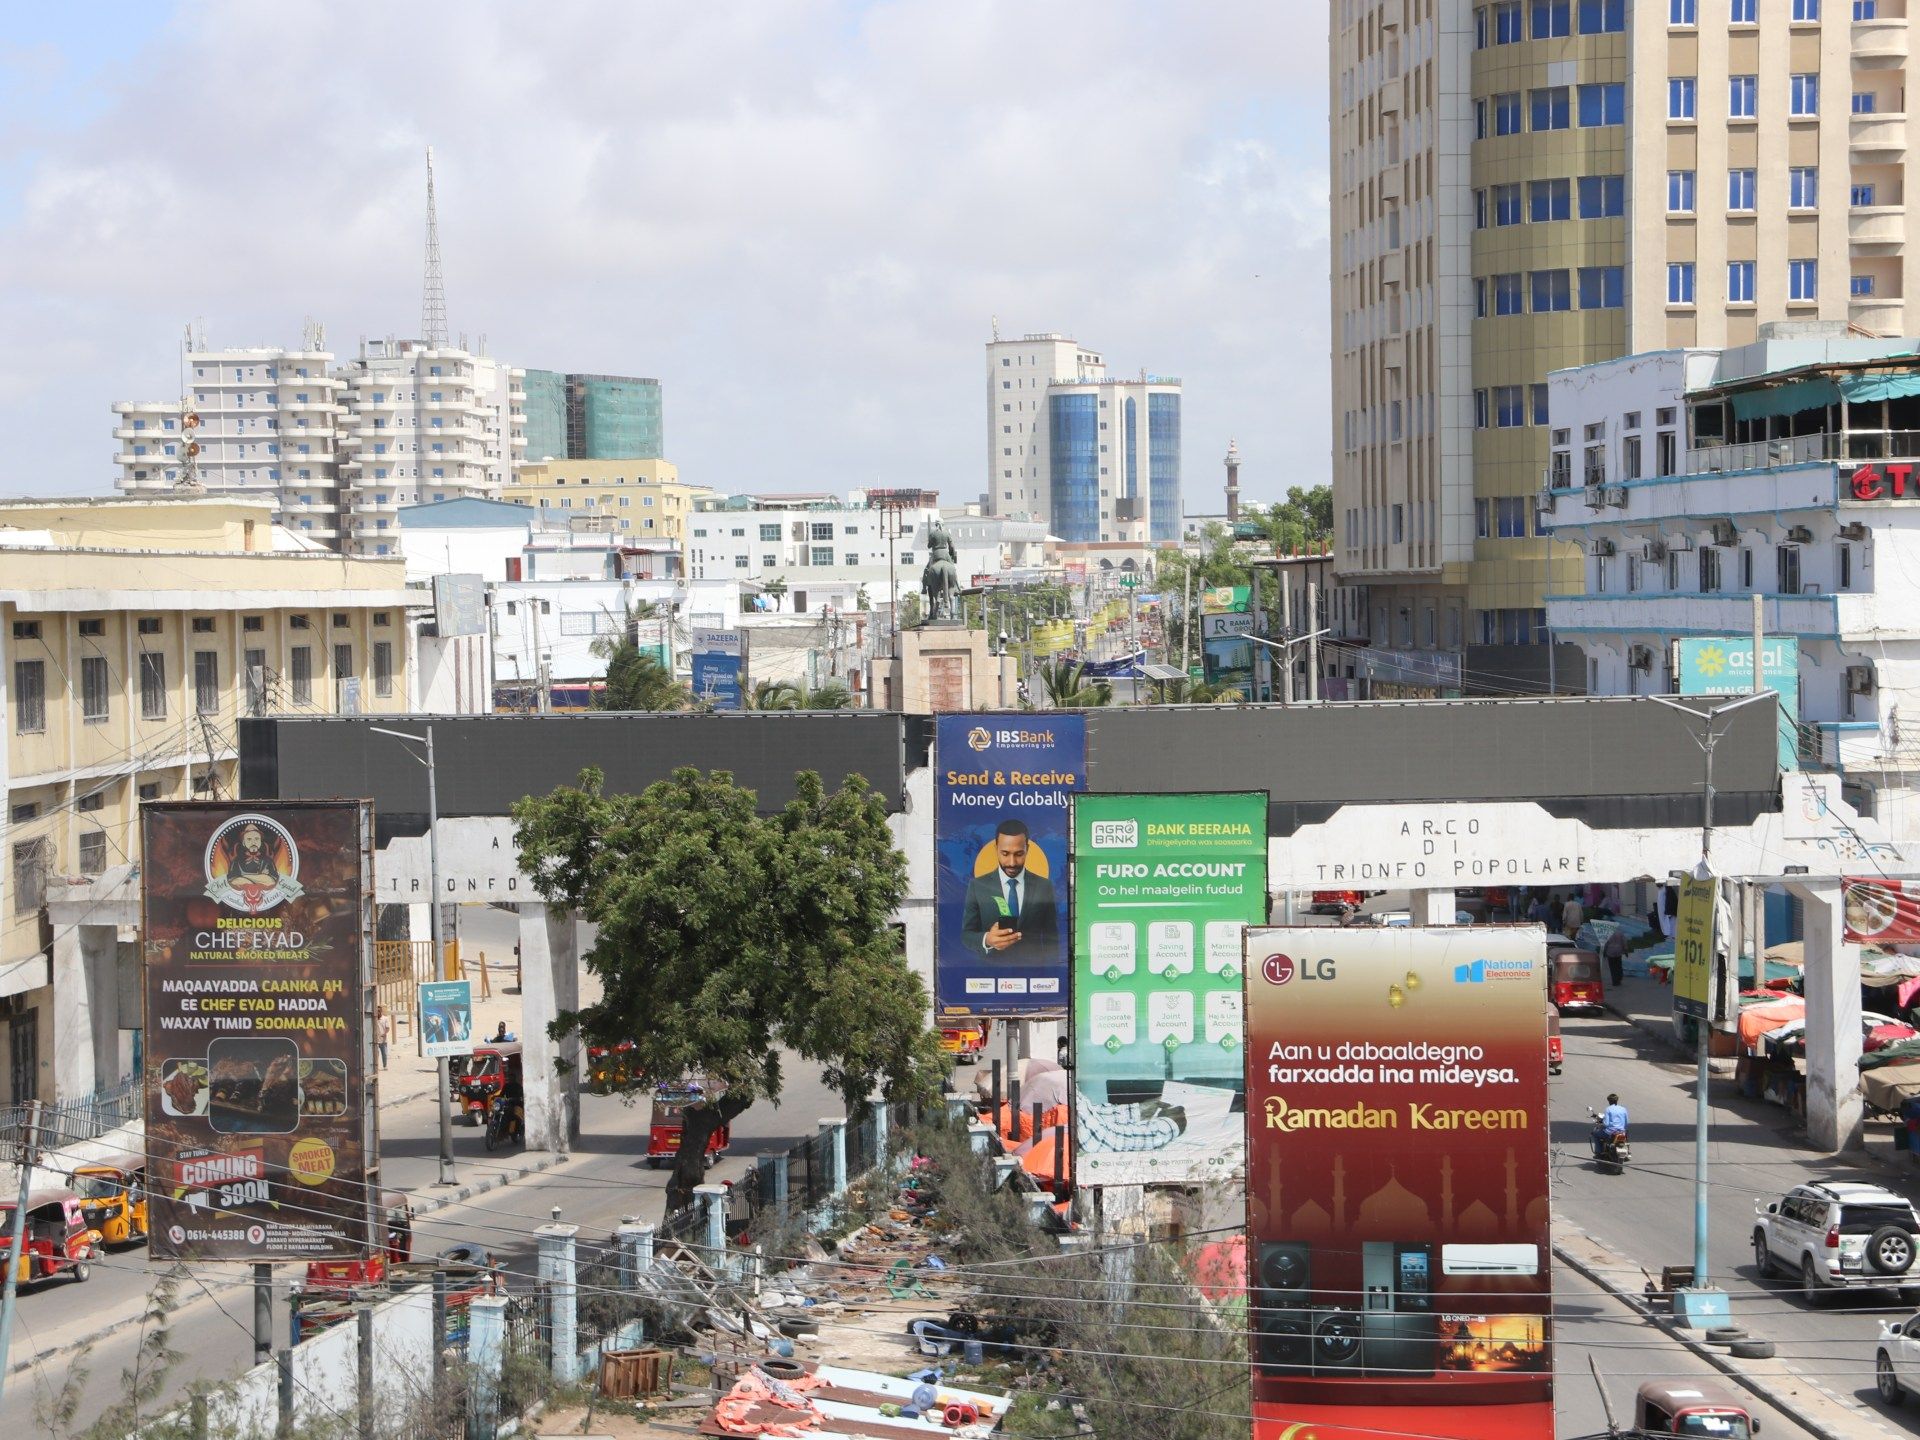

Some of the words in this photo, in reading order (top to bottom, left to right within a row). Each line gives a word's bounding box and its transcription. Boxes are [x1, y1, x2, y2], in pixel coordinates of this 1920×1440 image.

[706, 634, 738, 642] JAZEERA
[996, 730, 1054, 743] IBSBank
[947, 770, 988, 785] Send
[994, 771, 1006, 785] &
[1011, 770, 1074, 785] Receive
[952, 793, 1004, 809] Money
[1009, 791, 1068, 808] Globally
[1095, 824, 1134, 833] AGRO
[1147, 824, 1184, 835] BANK
[1189, 824, 1251, 834] BEERAHA
[1401, 819, 1479, 836] ARCO
[1095, 835, 1134, 843] BANK
[1096, 864, 1148, 878] FURO
[1154, 864, 1246, 877] ACCOUNT
[1317, 862, 1426, 880] TRIONFO
[1454, 856, 1586, 876] POPOLARE
[392, 878, 516, 892] TRONFO
[1099, 886, 1116, 896] Oo
[1120, 885, 1138, 895] hel
[1143, 885, 1202, 897] maalgelin
[1206, 884, 1243, 894] fudud
[216, 918, 282, 928] DELICIOUS
[195, 933, 247, 948] CHEF
[253, 933, 303, 948] EYAD
[190, 951, 232, 960] NATURAL
[278, 951, 309, 959] MEATS
[1301, 958, 1336, 980] LG
[1484, 960, 1532, 969] National
[163, 980, 258, 995] MAQAAYADDA
[262, 980, 318, 992] CAANKA
[323, 980, 342, 992] AH
[181, 999, 197, 1011] EE
[201, 999, 236, 1011] CHEF
[239, 999, 275, 1011] EYAD
[278, 999, 327, 1011] HADDA
[161, 1018, 209, 1030] WAXAY
[214, 1018, 252, 1029] TIMID
[256, 1017, 345, 1029] SOOMAALIYA
[1269, 1042, 1312, 1060] Aan
[1318, 1046, 1330, 1060] u
[1336, 1042, 1483, 1065] dabaaldegno
[1268, 1066, 1372, 1083] farxadda
[1380, 1065, 1413, 1083] ina
[1420, 1065, 1519, 1087] mideysa.
[1264, 1096, 1398, 1132] Ramadan
[1409, 1103, 1526, 1130] Kareem
[180, 1151, 193, 1159] STAY
[292, 1147, 331, 1163] SMOKED
[182, 1155, 257, 1185] COMING
[298, 1158, 332, 1172] MEAT
[221, 1180, 270, 1207] SOON
[187, 1230, 244, 1240] 0614-445388
